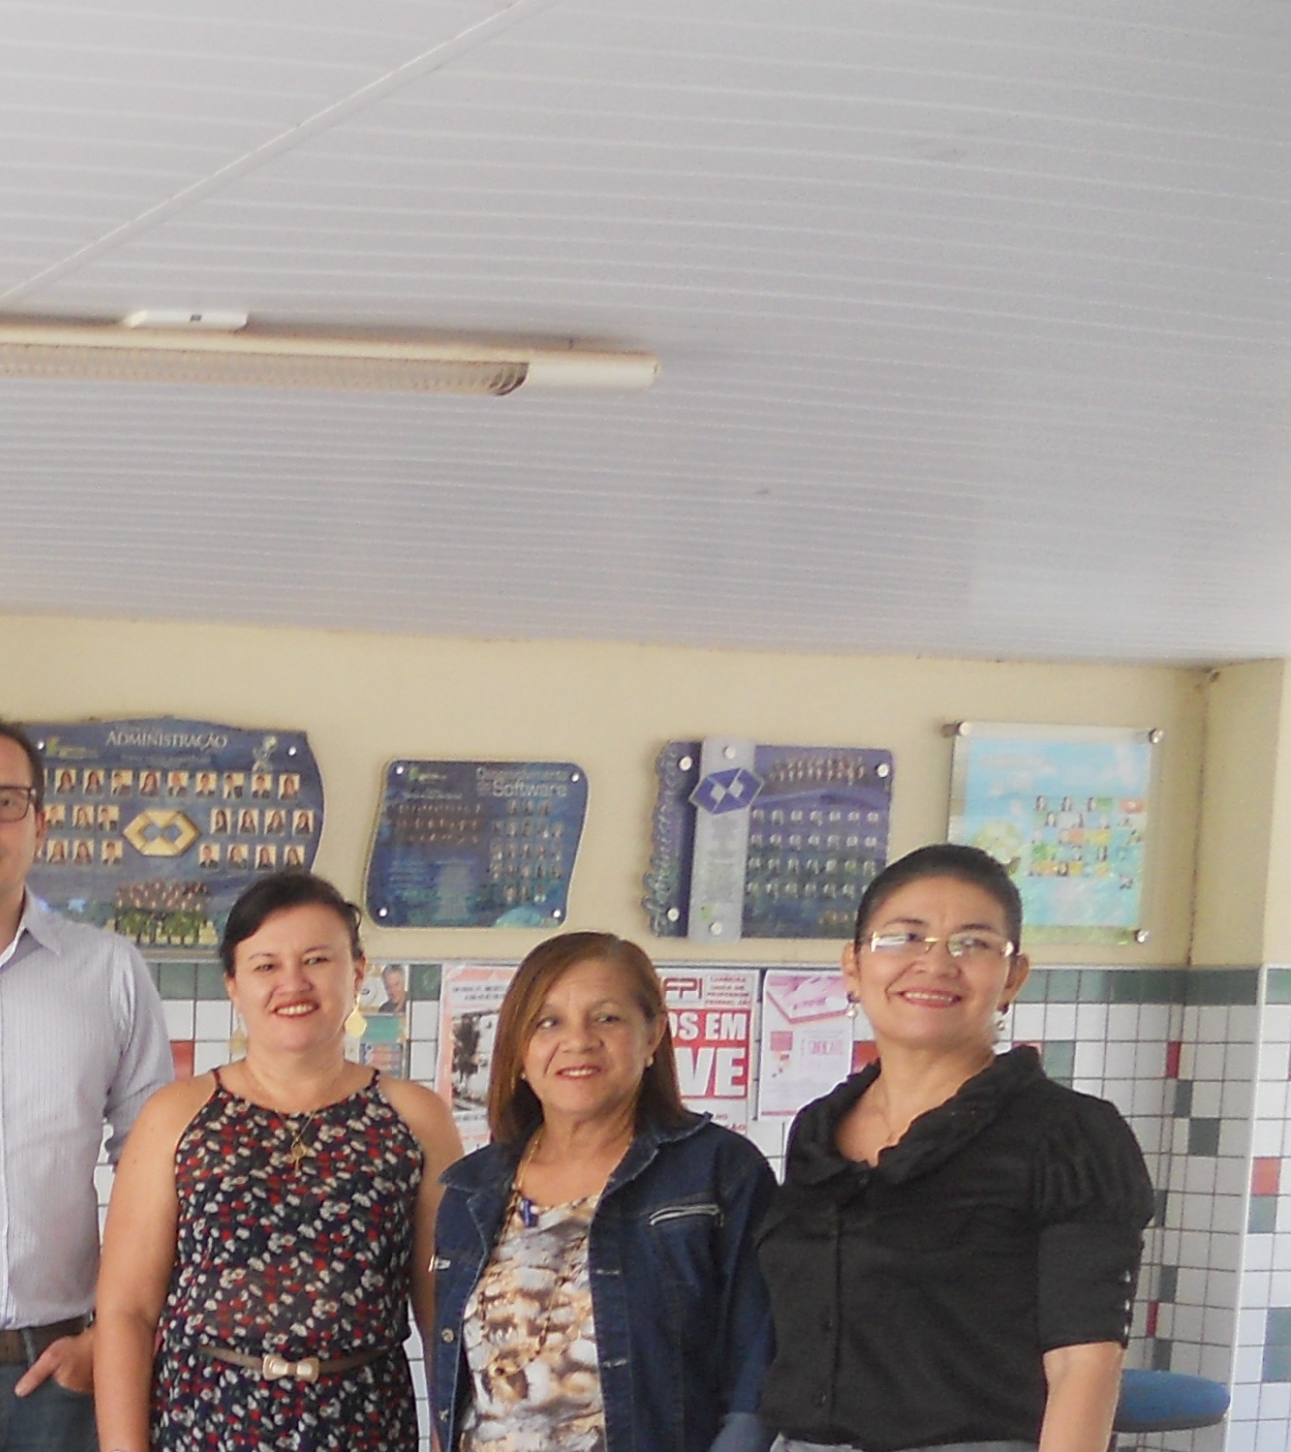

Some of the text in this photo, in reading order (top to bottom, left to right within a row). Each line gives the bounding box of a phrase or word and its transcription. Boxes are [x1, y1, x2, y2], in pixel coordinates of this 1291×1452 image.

[106, 730, 229, 752] ADMINISTRAÇÃO
[492, 779, 568, 797] Software
[705, 1012, 747, 1042] EM
